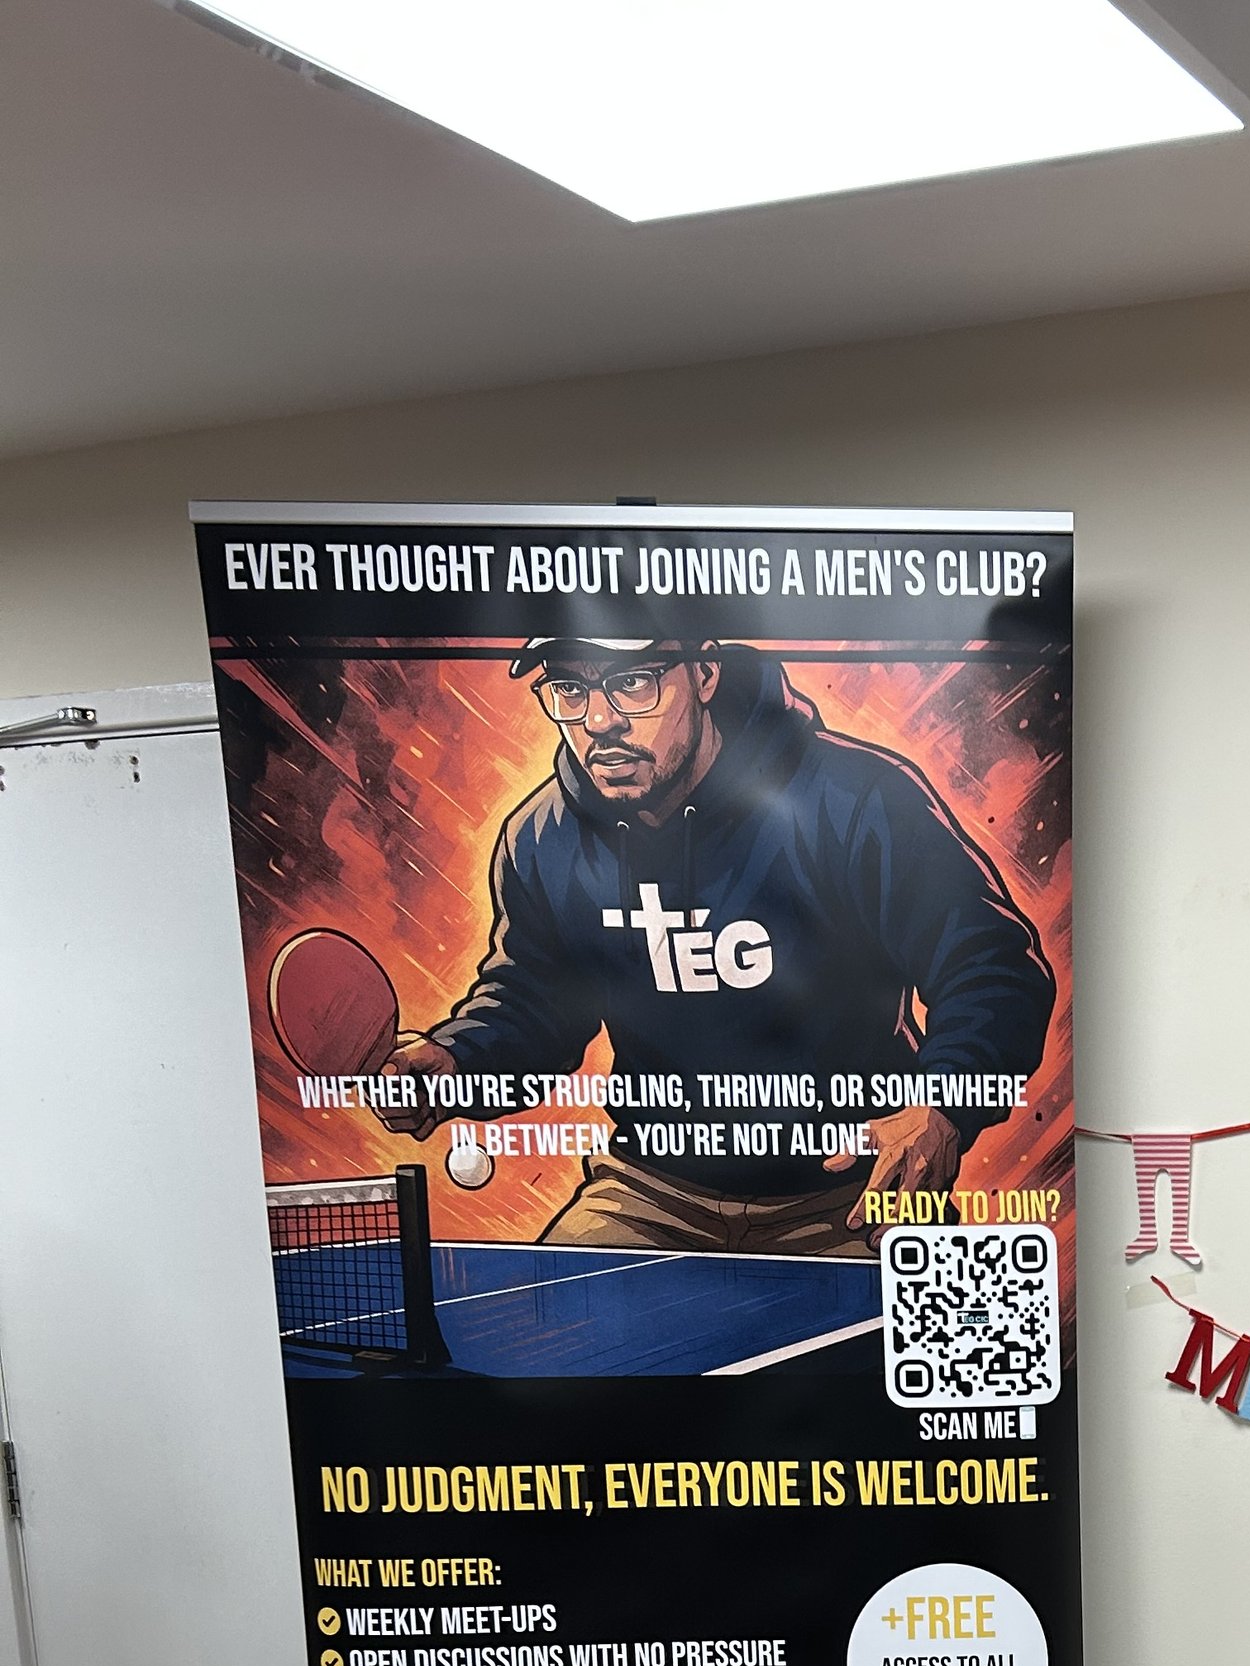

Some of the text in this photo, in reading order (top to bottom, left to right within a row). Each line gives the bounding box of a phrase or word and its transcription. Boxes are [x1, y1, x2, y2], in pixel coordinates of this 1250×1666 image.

[226, 544, 1046, 597] EVER THOUGHT ABOUT JOINING A MEN'S CLUB?
[297, 1074, 1027, 1112] WHETHER YOU'RE STRUGGLING, THRIVING, OR SOMEWHERE
[450, 1123, 879, 1157] IN BETWEEN - YOU'RE NOT ALONE.
[866, 1190, 1060, 1223] READY TO JOIN?
[920, 1411, 1016, 1440] SCAN ME
[322, 1458, 1048, 1516] NO JUDGMENT, EVERYONE IS WELCOME.
[315, 1559, 501, 1587] WHAT WE OFFER:
[346, 1605, 556, 1635] WEEKLY MEET-UPS
[883, 1596, 995, 1639] +FREE
